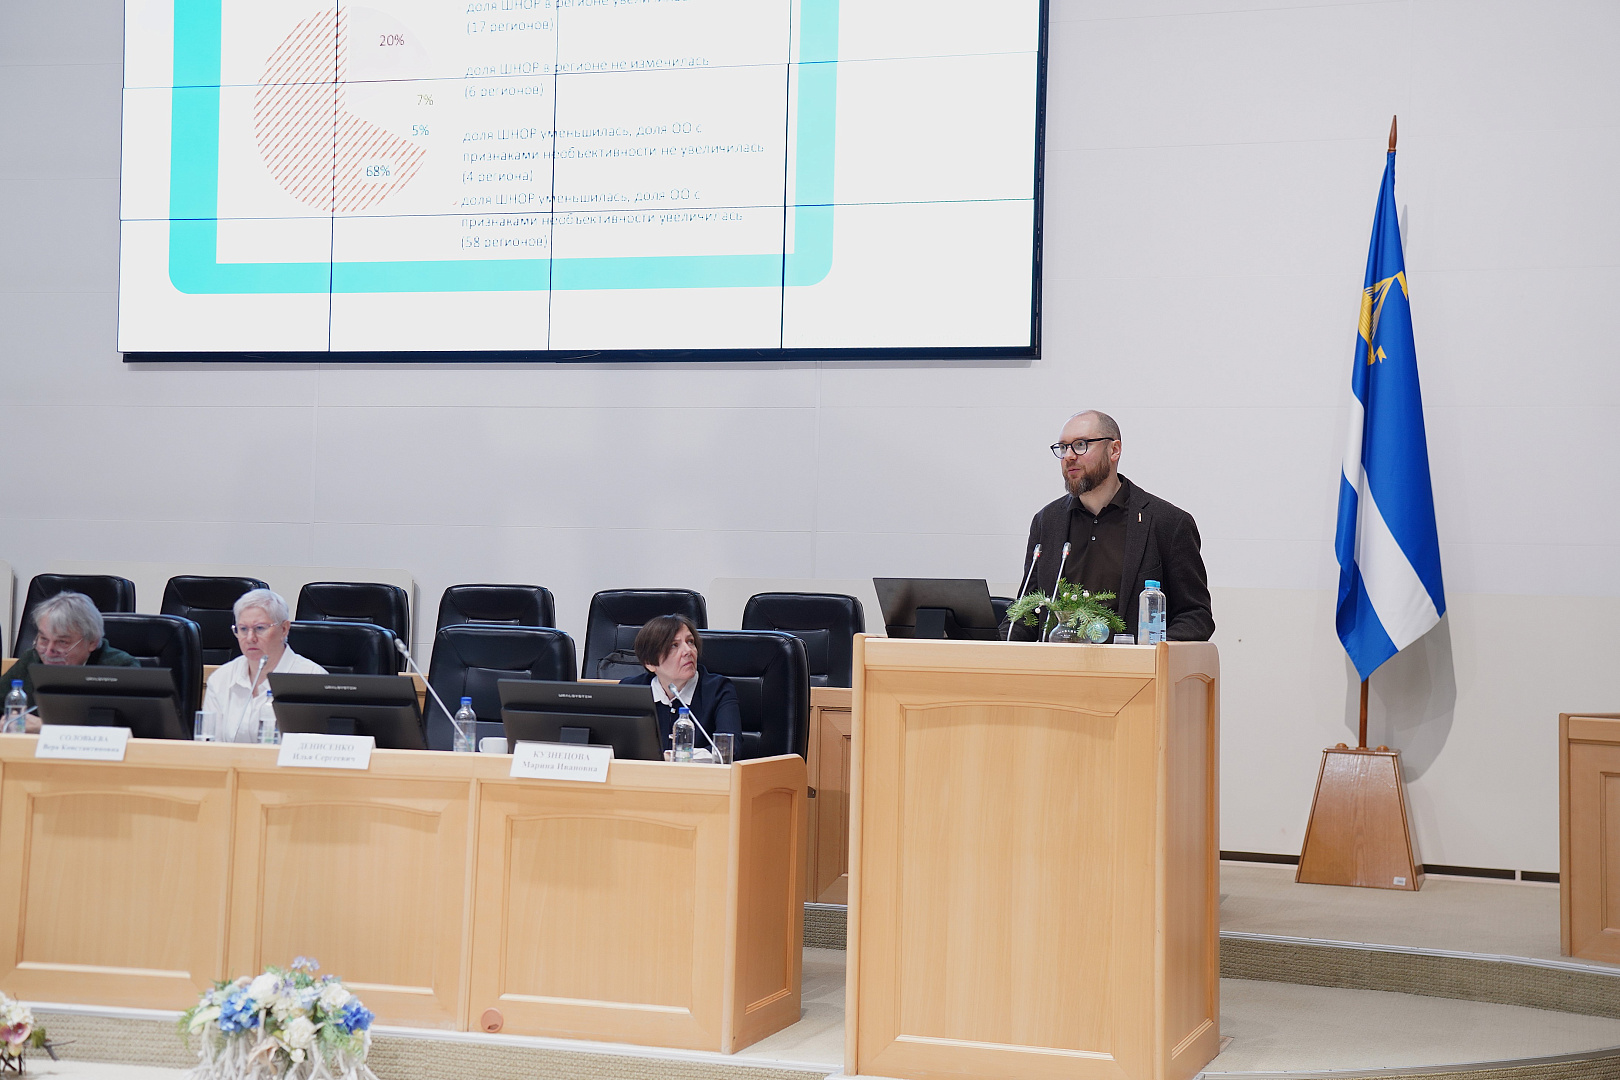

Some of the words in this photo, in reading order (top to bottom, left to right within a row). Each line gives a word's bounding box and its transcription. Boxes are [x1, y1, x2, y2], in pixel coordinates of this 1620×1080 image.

[466, 2, 498, 14] доля
[466, 20, 486, 36] (17
[490, 18, 554, 33] регионов)
[379, 34, 405, 47] 20%
[465, 66, 497, 79] доля
[500, 62, 539, 75] ШНОР
[544, 64, 550, 73] в
[555, 61, 608, 74] регионе
[611, 60, 627, 71] не
[630, 57, 709, 69] изменилась
[464, 86, 477, 99] (6
[480, 83, 544, 98] регионов)
[417, 94, 434, 106] 7%
[412, 124, 430, 137] 5%
[462, 132, 494, 143] доля
[497, 127, 537, 140] ШНОР
[540, 126, 632, 141] уменьшилась,
[636, 125, 668, 137] доля
[696, 124, 702, 133] с
[463, 151, 539, 164] признаками
[543, 146, 657, 160] необъективности
[661, 146, 677, 156] не
[680, 143, 764, 157] увеличилась
[366, 165, 391, 177] 68%
[462, 171, 473, 184] (4
[478, 169, 533, 182] региона)
[461, 196, 492, 208] доля
[495, 192, 535, 205] ШНОР
[538, 191, 630, 207] уменьшилась,
[634, 191, 665, 203] доля
[694, 190, 700, 200] с
[461, 216, 538, 230] признаками
[541, 212, 655, 226] необъективности
[659, 212, 743, 226] увеличилась
[461, 235, 480, 251] (58
[484, 234, 549, 249] регионов)
[532, 750, 591, 762] КУЗНЕЦОВА
[521, 760, 556, 772] Марина
[556, 762, 599, 773] Ивановна
